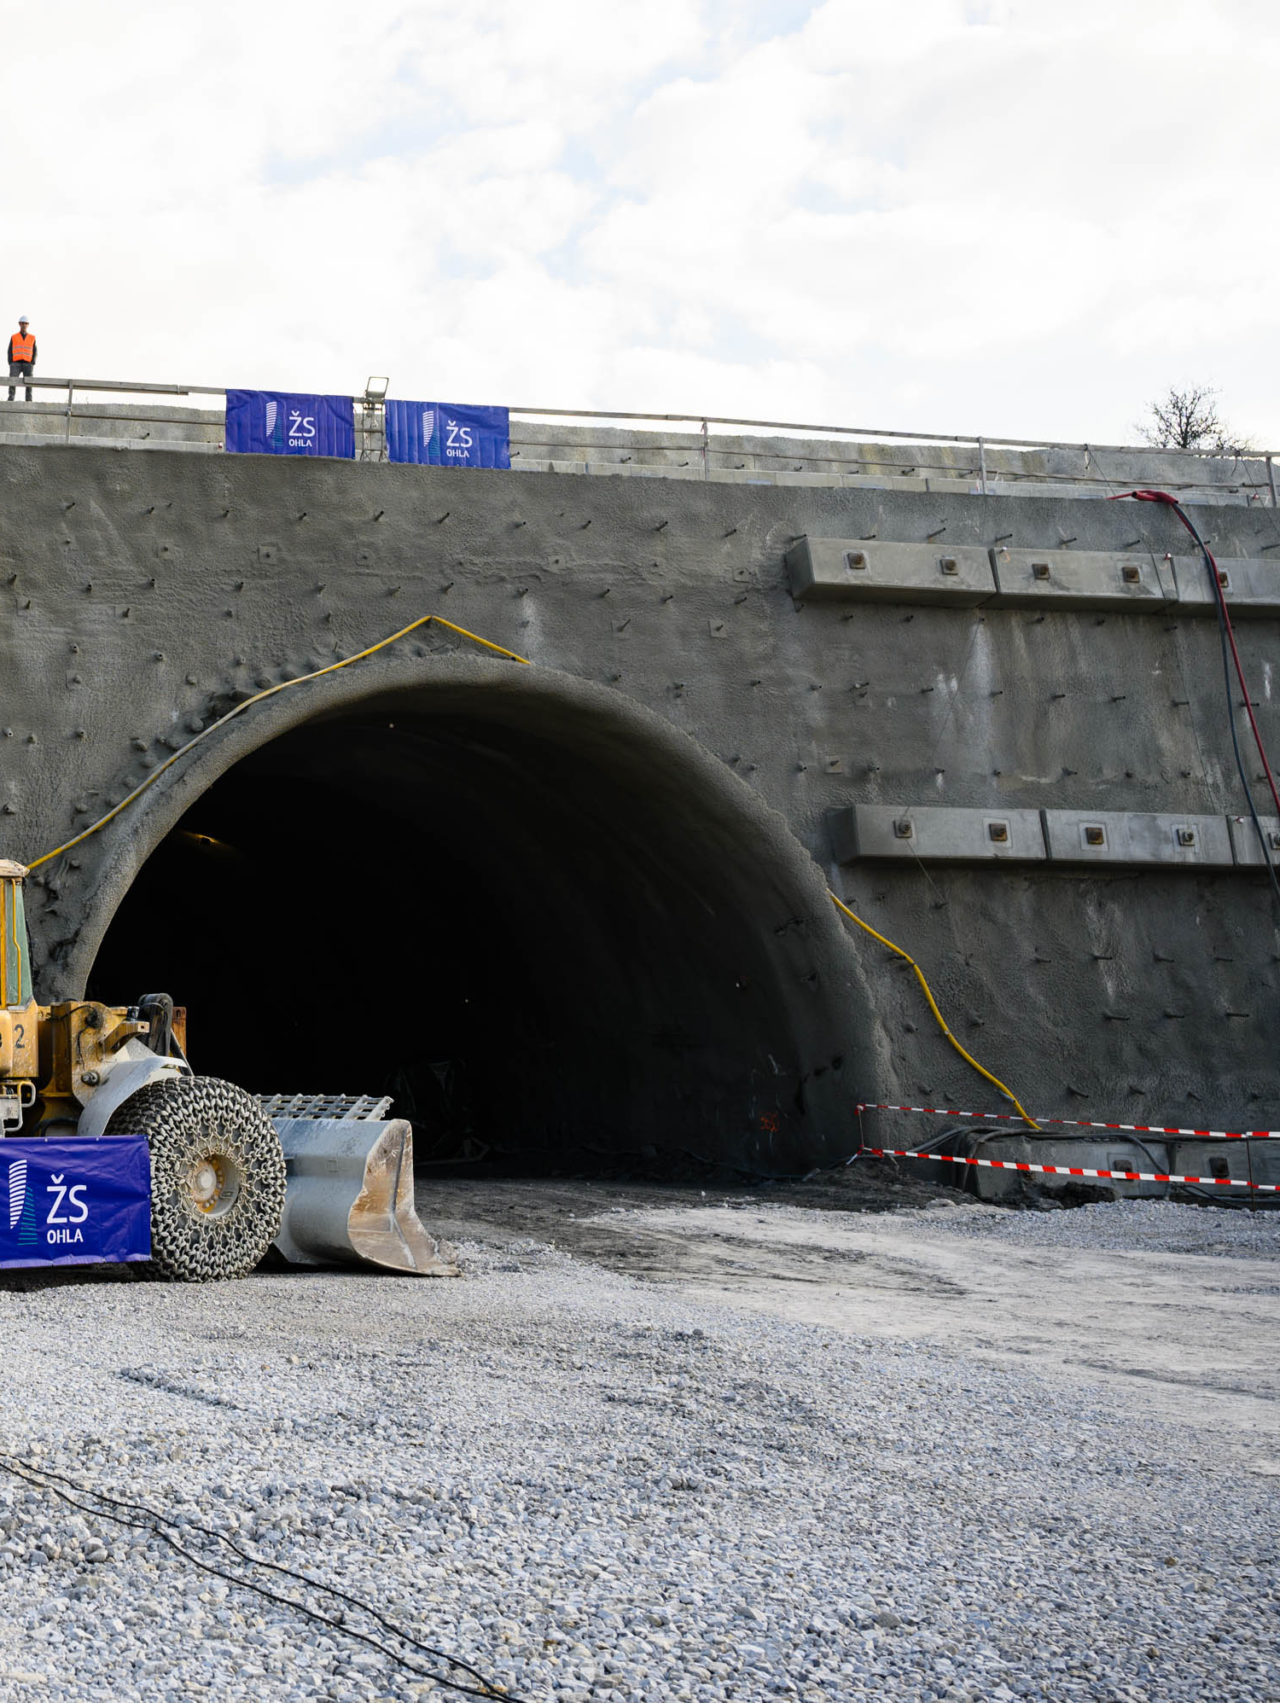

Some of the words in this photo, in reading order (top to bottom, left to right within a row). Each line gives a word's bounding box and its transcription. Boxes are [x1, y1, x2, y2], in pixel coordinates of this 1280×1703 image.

[288, 410, 316, 437] ŽS
[446, 419, 473, 448] ŽS
[288, 438, 313, 447] OHLA
[446, 449, 470, 458] OHLA
[14, 1023, 25, 1049] 2
[46, 1173, 89, 1224] ŽS
[46, 1228, 84, 1244] OHLA
